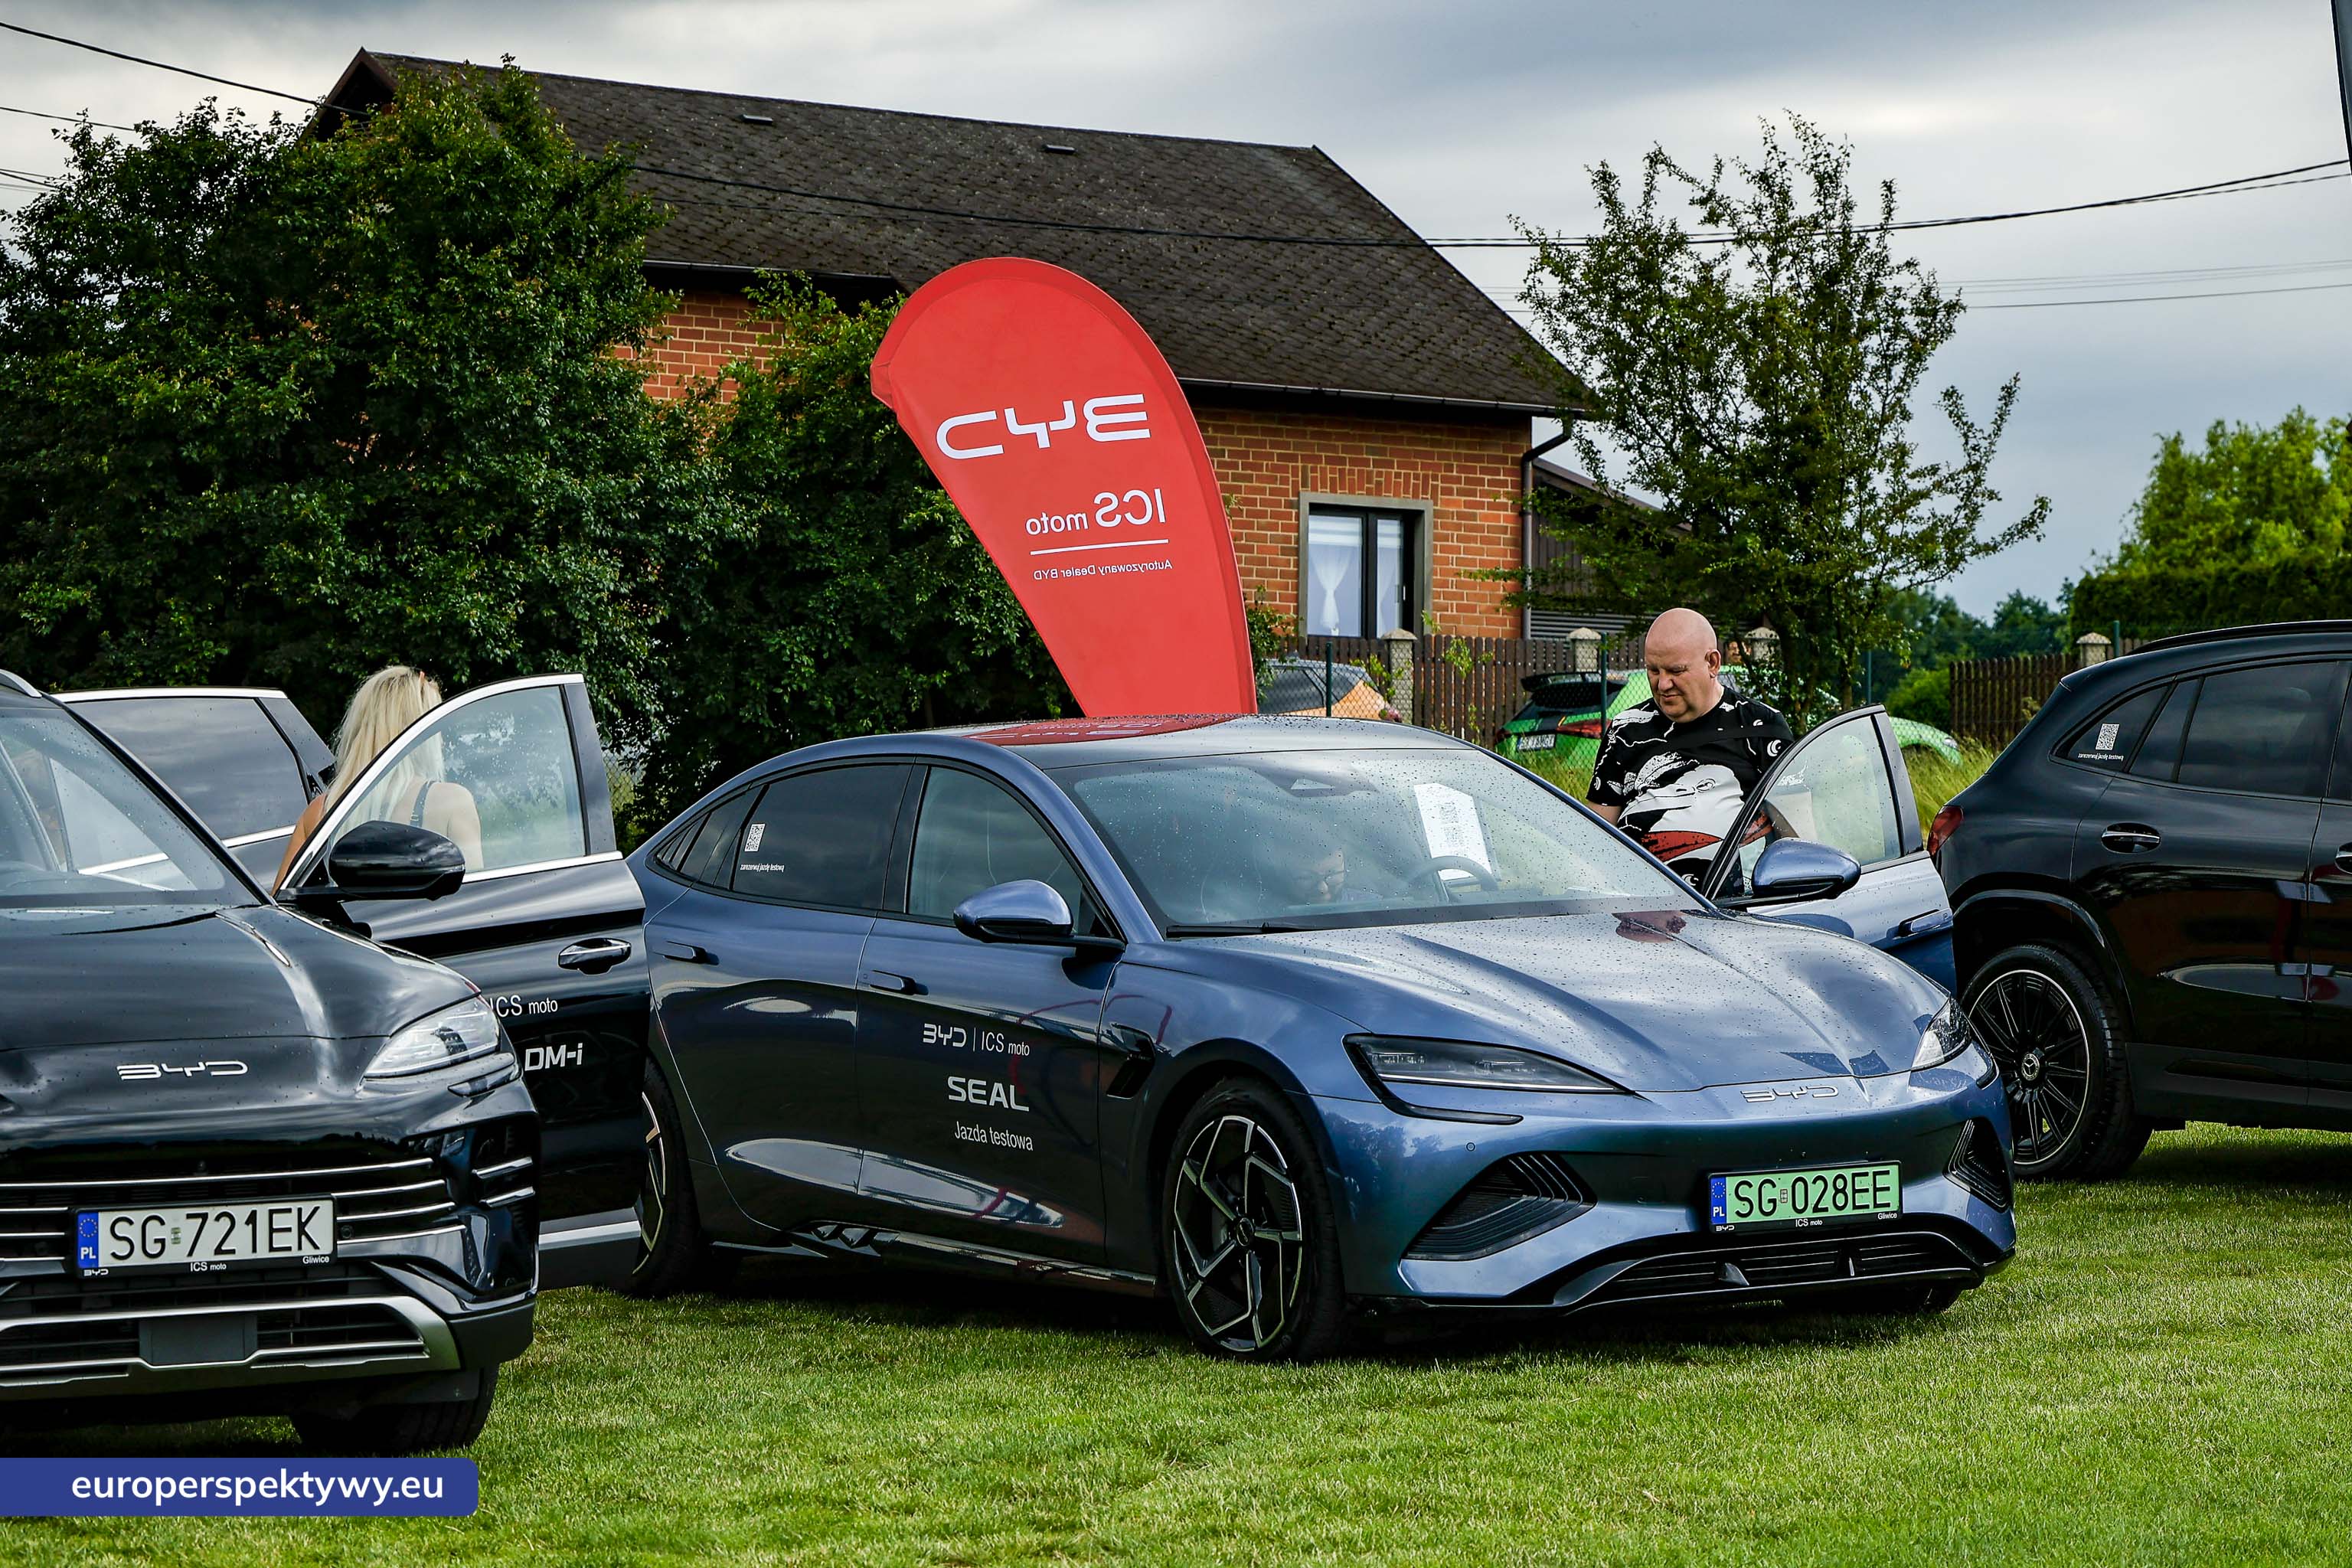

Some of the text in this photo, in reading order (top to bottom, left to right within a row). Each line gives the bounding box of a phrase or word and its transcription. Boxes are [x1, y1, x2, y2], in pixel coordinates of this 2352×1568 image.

[528, 998, 558, 1014] moto
[923, 1023, 1030, 1056] BYD ICS moto
[524, 1043, 583, 1071] DM-i
[116, 1060, 248, 1080] BYD
[947, 1076, 1030, 1112] SEAL
[1740, 1085, 1838, 1102] BYD
[955, 1121, 1034, 1151] Jazda testowa
[1713, 1207, 1725, 1217] PL
[1877, 1212, 1897, 1220] Gliwice
[1795, 1219, 1809, 1227] ICS
[80, 1247, 96, 1259] PL
[302, 1255, 330, 1265] Gliwice
[190, 1262, 227, 1272] ICS moto
